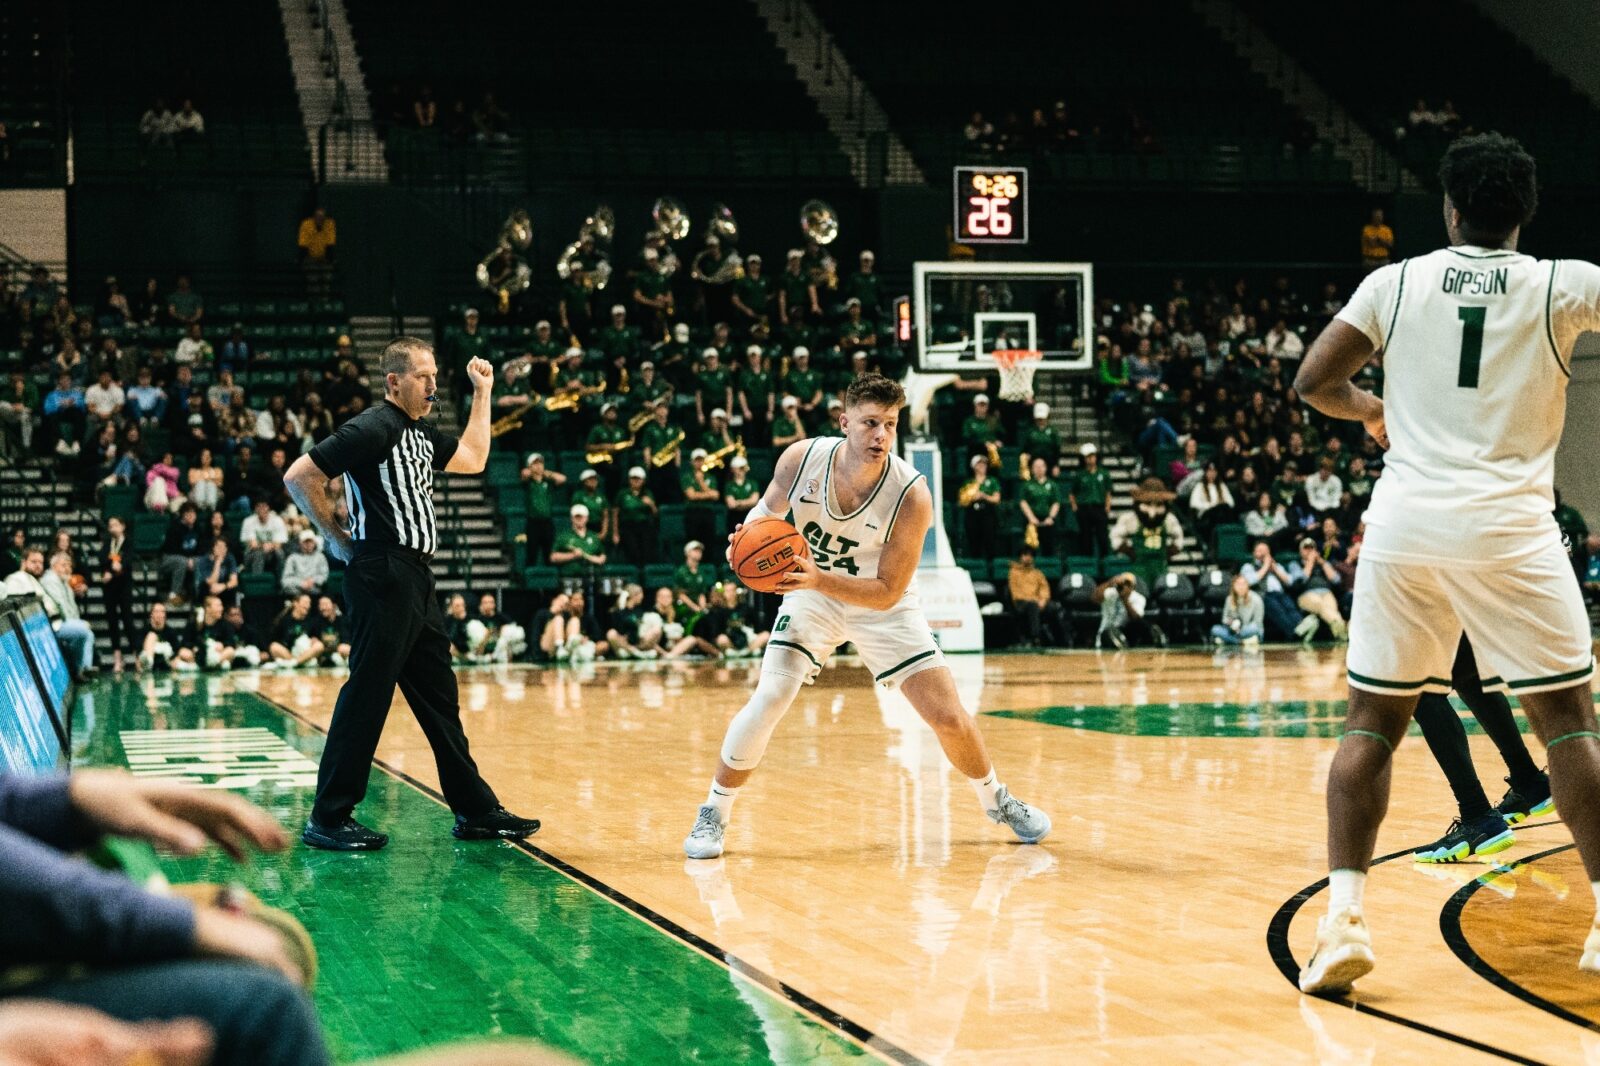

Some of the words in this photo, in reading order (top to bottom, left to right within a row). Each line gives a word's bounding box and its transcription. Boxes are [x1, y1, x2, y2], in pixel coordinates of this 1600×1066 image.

[972, 174, 1019, 198] 9:26
[968, 197, 1012, 235] 26
[1442, 267, 1508, 295] GIPSON
[1457, 306, 1487, 389] 1
[756, 545, 795, 572] ELITE
